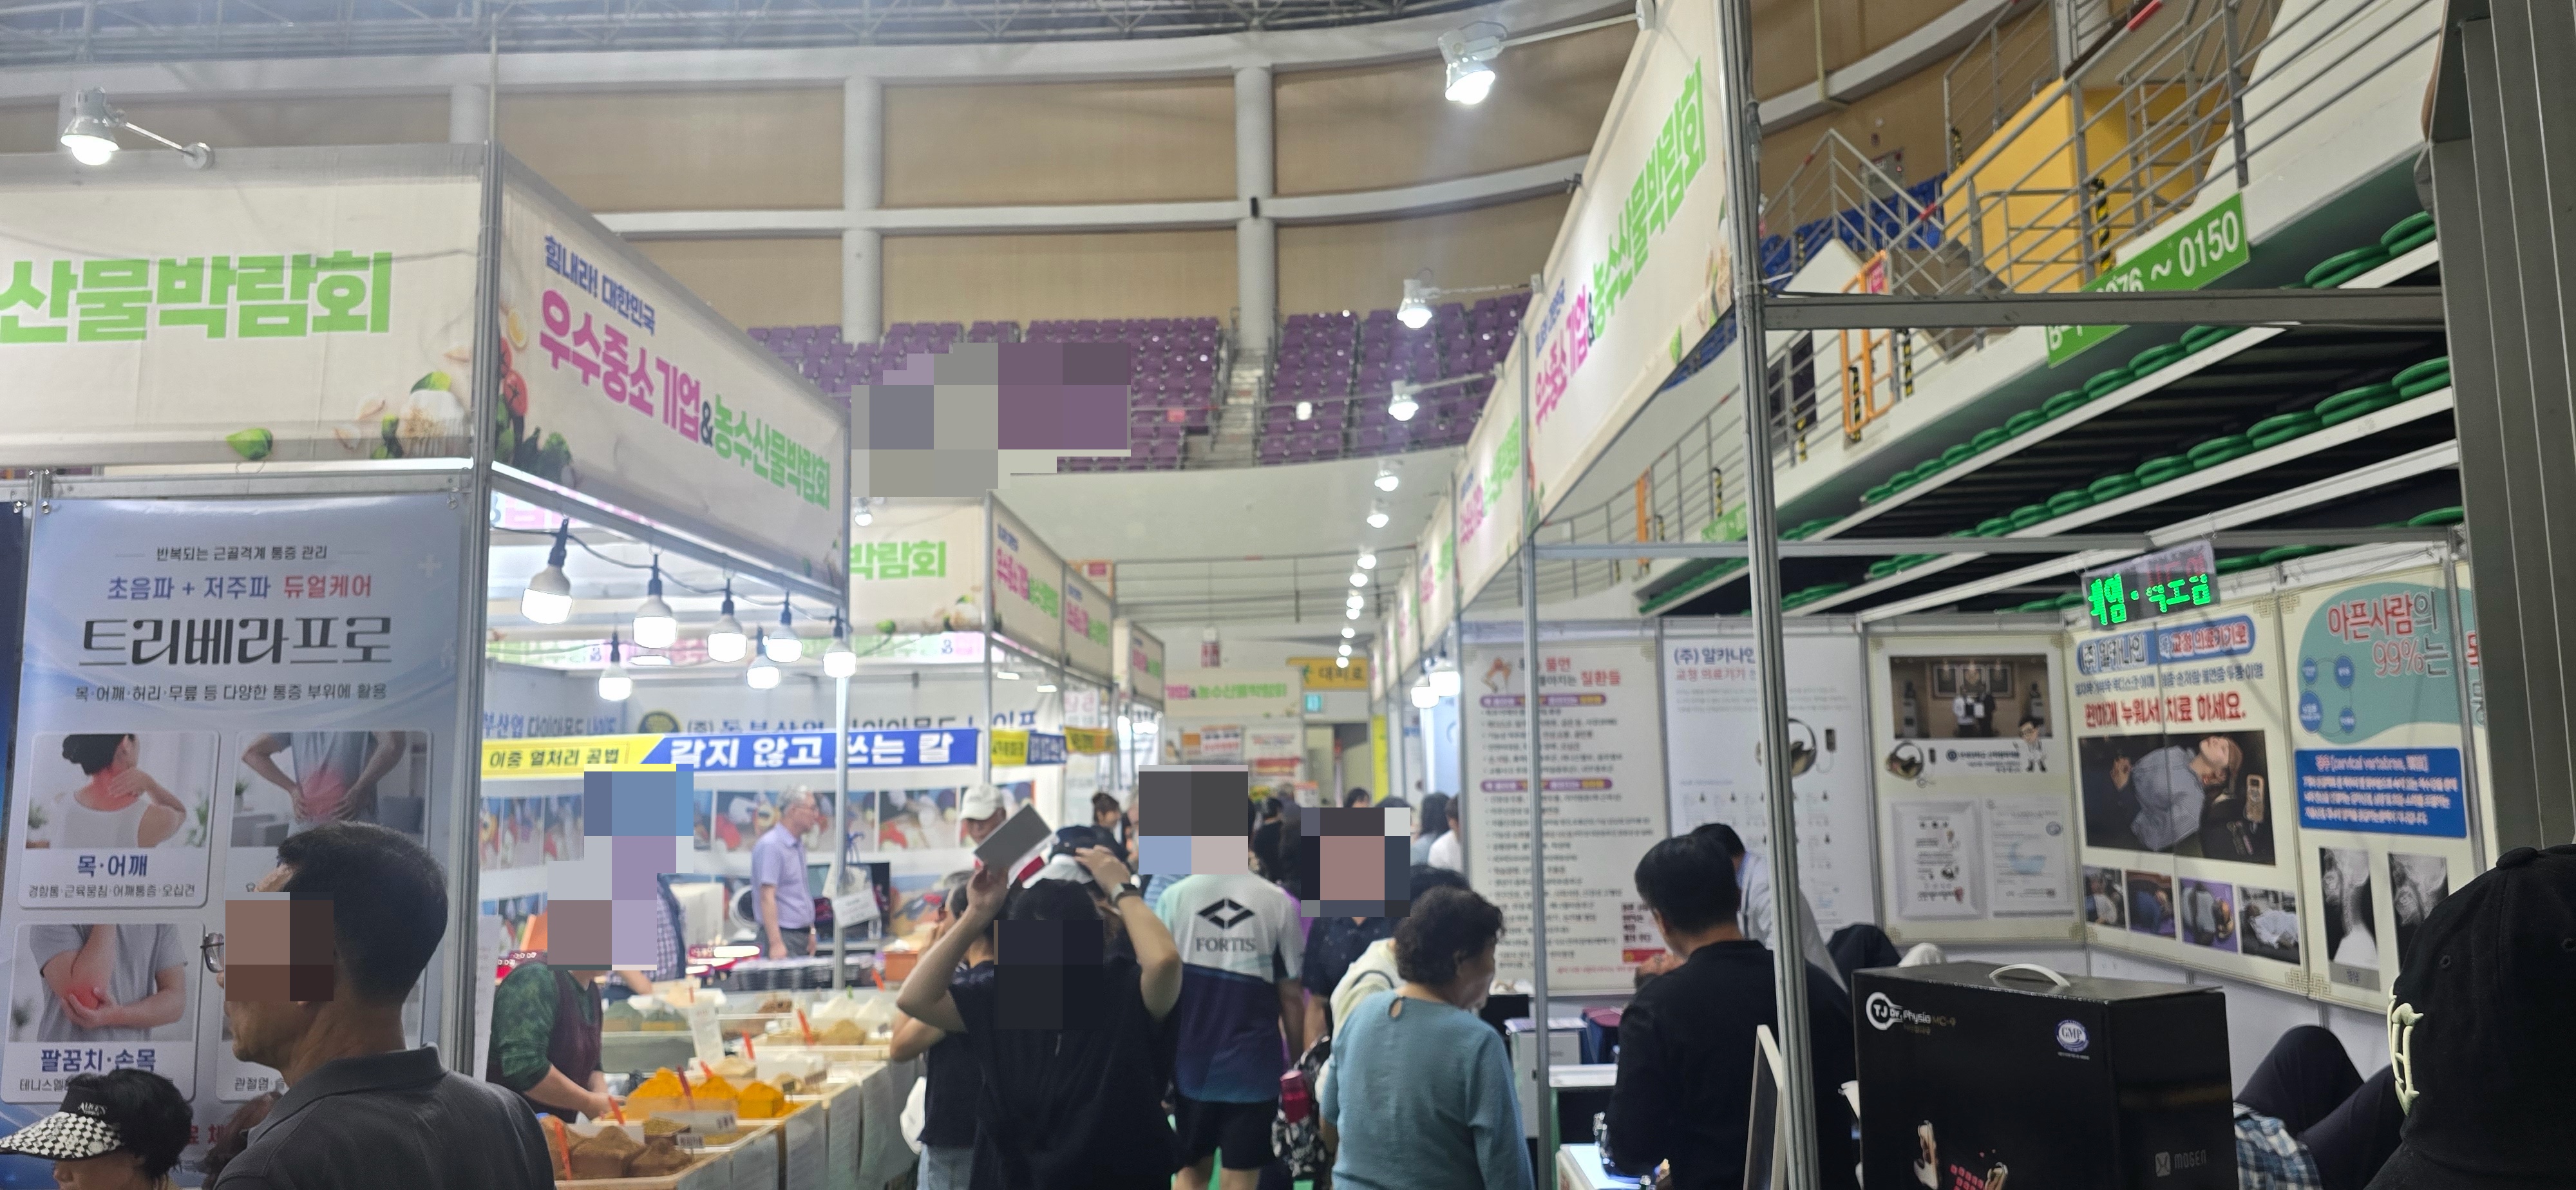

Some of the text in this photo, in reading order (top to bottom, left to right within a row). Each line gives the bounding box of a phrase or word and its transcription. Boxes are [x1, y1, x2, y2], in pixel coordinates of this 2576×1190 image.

[2179, 210, 2240, 277] 0150
[545, 235, 656, 337] 힘내라! 대한민국
[540, 289, 831, 511] 우수중소기업&농수산물박람회
[156, 544, 328, 562] 반복되는 근골격계 통증 관리
[108, 577, 175, 600] 초음파
[204, 575, 271, 599] 저주파
[283, 574, 372, 598] 듀얼케어
[2327, 589, 2438, 642] 아픈사람의
[79, 616, 393, 666] 트리베라프로
[1674, 647, 1700, 666] (주)
[2372, 636, 2449, 677] 99%는
[204, 685, 218, 701] 등
[223, 683, 268, 701] 다양한
[272, 683, 302, 701] 통증
[307, 683, 352, 701] 부위에
[357, 683, 388, 701] 활용
[2084, 701, 2119, 729] 편하게
[2121, 697, 2162, 724] 누워서
[2165, 694, 2193, 722] 치료
[490, 748, 620, 768] 이중 열처리 공법
[670, 737, 740, 768] 갈지
[753, 736, 822, 768] 않고
[918, 732, 954, 764] 칼
[1195, 936, 1256, 952] FORTIS
[1873, 1004, 1888, 1018] TJ
[2061, 1026, 2083, 1039] GMP
